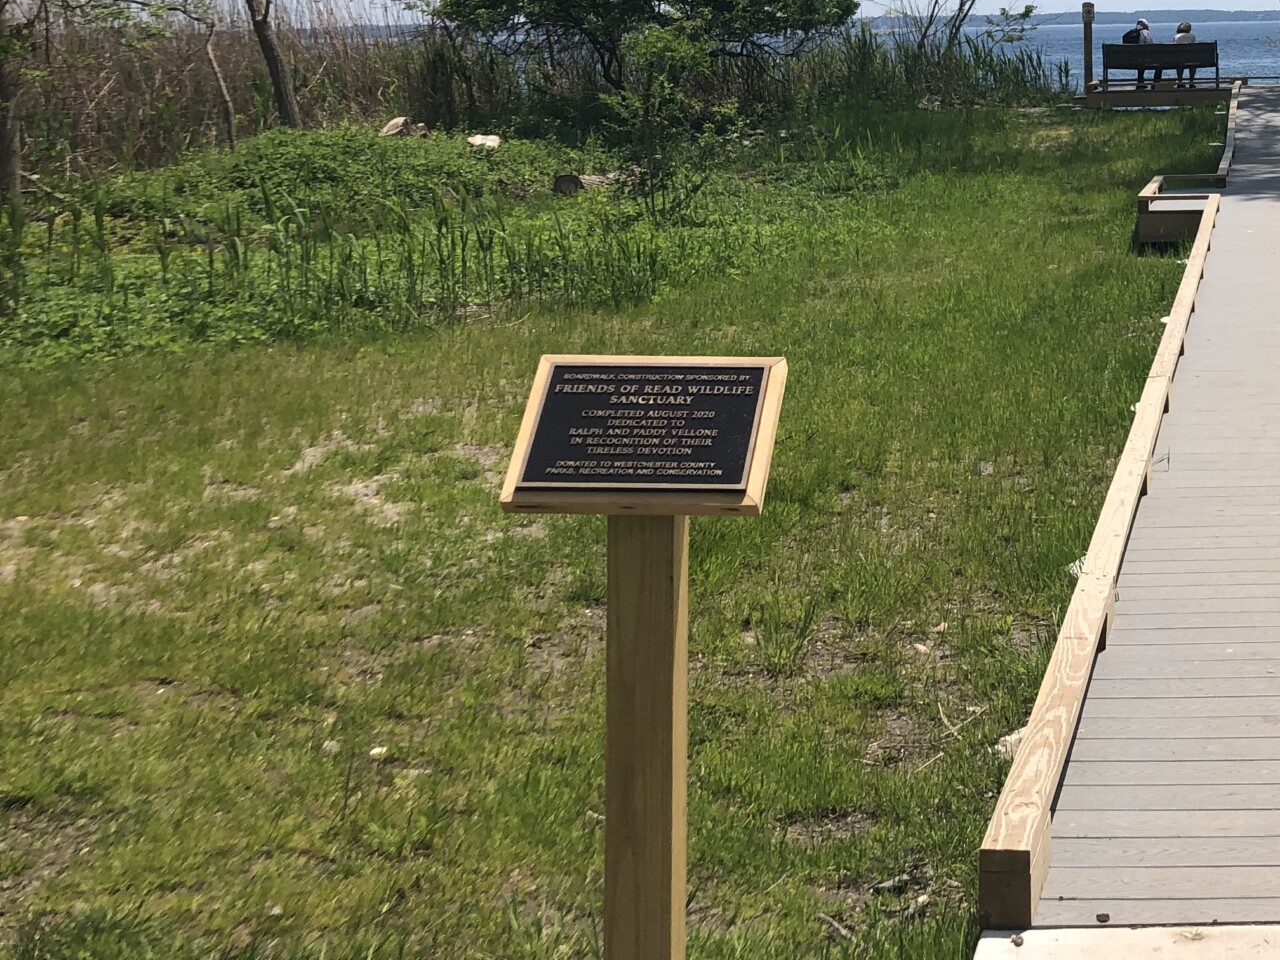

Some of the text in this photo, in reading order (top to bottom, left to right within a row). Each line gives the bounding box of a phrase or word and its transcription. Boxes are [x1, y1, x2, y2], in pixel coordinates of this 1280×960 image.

[555, 384, 753, 395] FRIENDS OF READ WILDLIFE
[609, 396, 694, 404] SANCTUARY
